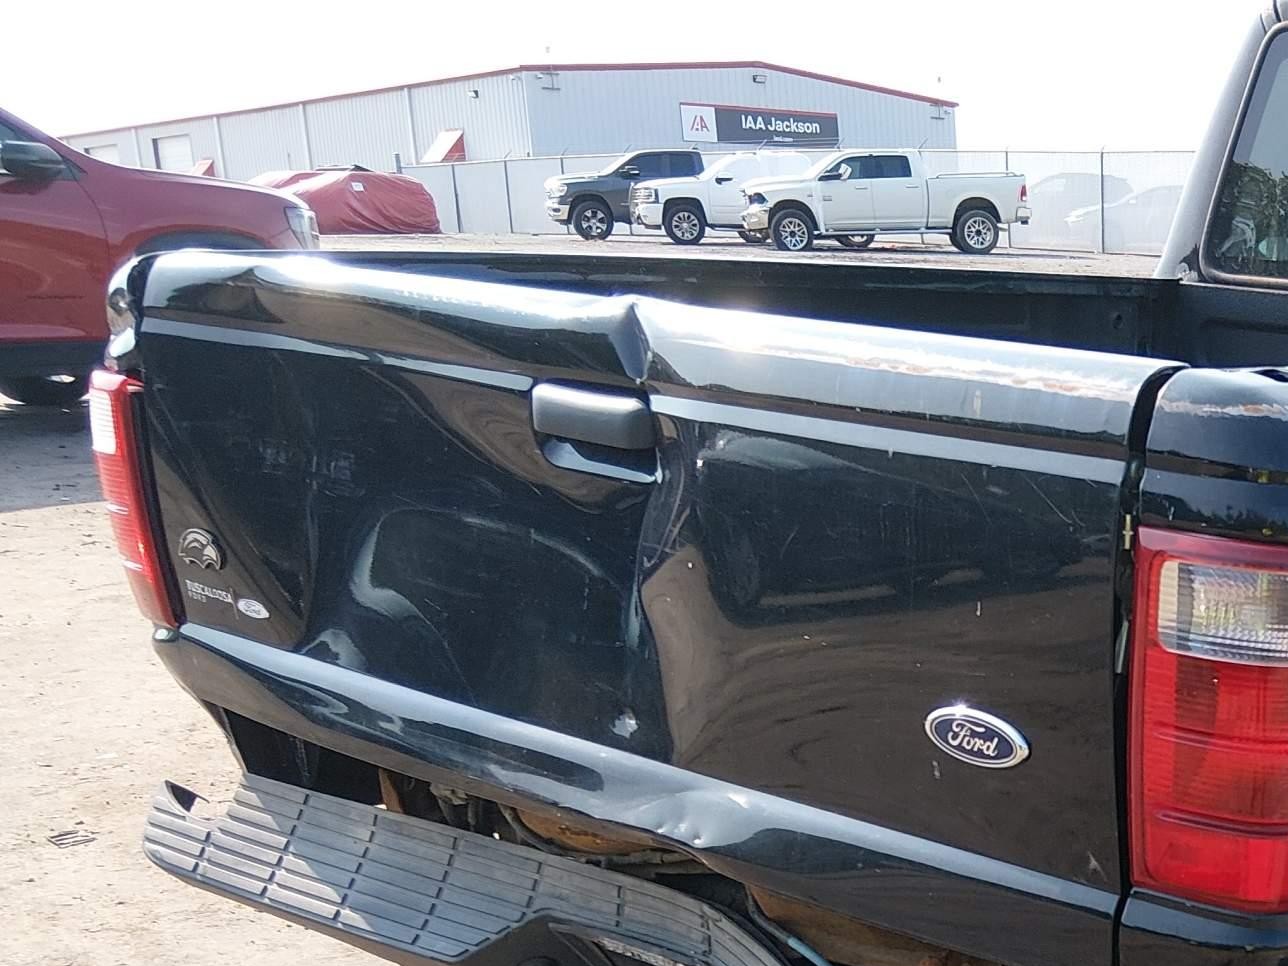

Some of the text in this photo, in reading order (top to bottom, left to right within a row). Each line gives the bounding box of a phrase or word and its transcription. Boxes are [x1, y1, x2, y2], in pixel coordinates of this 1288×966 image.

[741, 114, 820, 134] IAA Jackson
[947, 720, 999, 757] Ford
